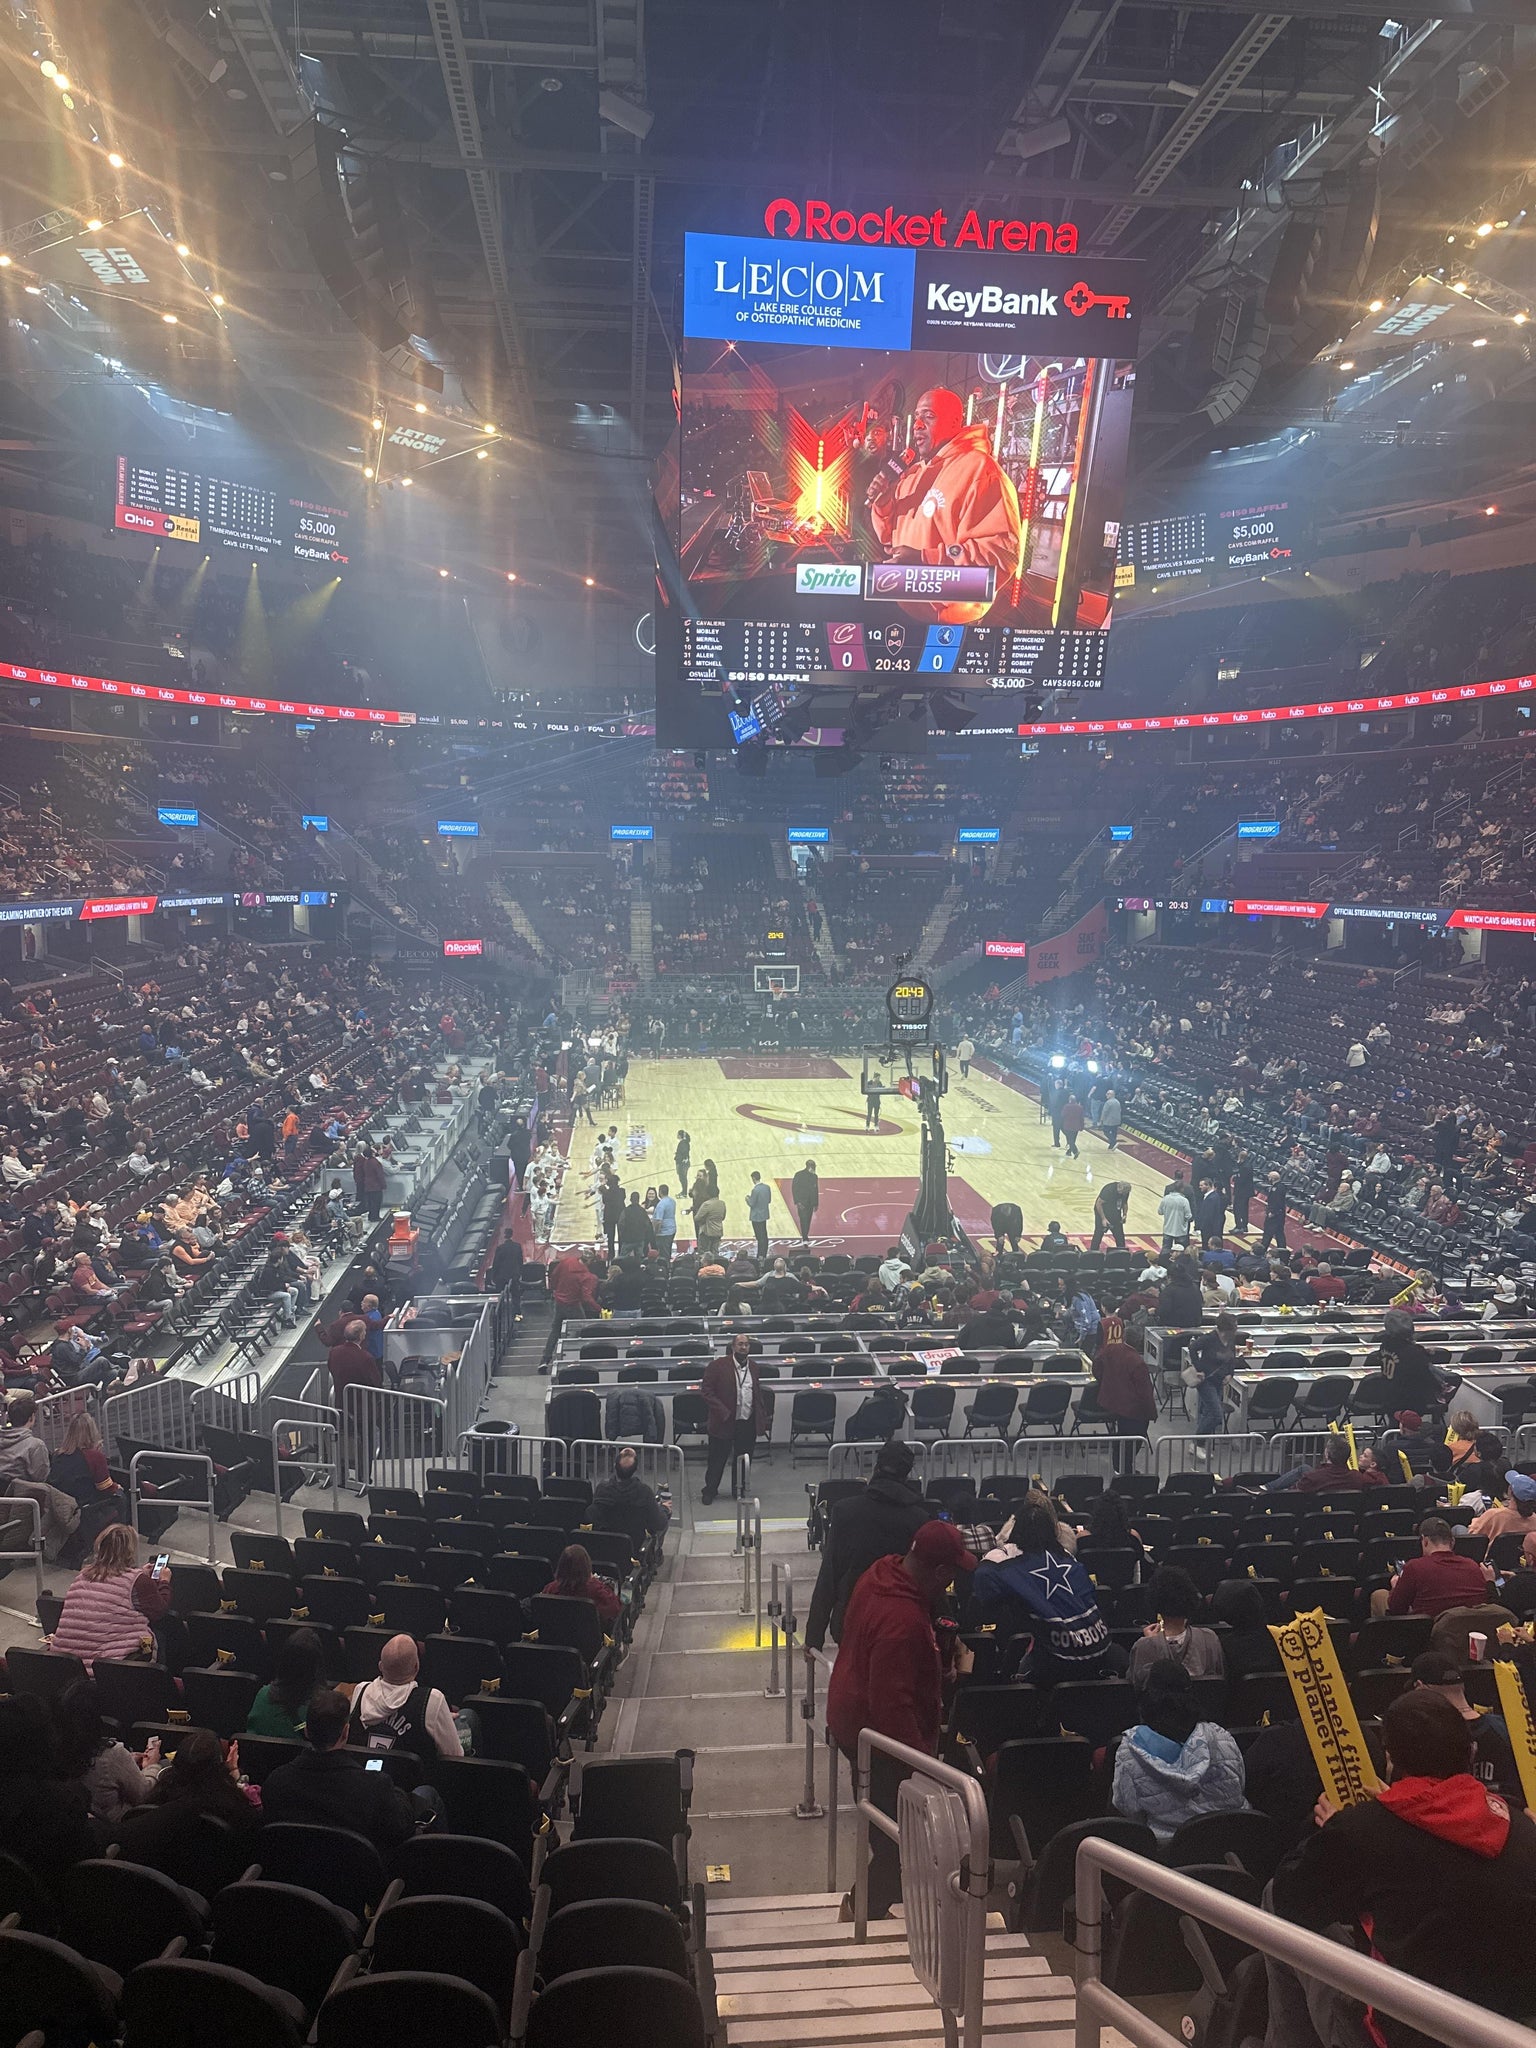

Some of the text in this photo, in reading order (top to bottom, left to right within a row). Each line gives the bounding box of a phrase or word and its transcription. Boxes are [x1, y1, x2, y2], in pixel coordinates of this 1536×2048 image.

[804, 199, 1078, 254] Rocket Arena
[105, 247, 150, 284] LET EM
[927, 283, 1058, 318] KeyBank
[754, 302, 842, 317] LAKE ERIE COLLEGE
[736, 311, 861, 329] OF OSTEOPATHIC MEDICINE
[395, 426, 447, 446] LET EM
[388, 434, 441, 455] KNOW.
[124, 513, 154, 527] Ohio
[299, 518, 336, 536] $5,000
[1232, 522, 1274, 540] $5,000
[294, 545, 330, 561] KeyBank
[1228, 552, 1269, 566] KeyBank
[800, 567, 857, 590] Sprite
[905, 568, 961, 582] DJ STEPH
[904, 581, 942, 593] FLOSS
[868, 631, 882, 641] 1Q
[842, 652, 852, 667] 0
[875, 659, 911, 671] 20:43
[932, 655, 943, 670] 0
[12, 667, 26, 679] fubo
[40, 672, 57, 684] fubo
[689, 668, 716, 678] oswald
[768, 673, 810, 681] RAFFLE
[71, 676, 88, 689] fubo
[991, 678, 1025, 689] $5,000
[1042, 679, 1101, 688] CAVS5050.COM
[1490, 684, 1506, 693] fubo
[1518, 680, 1532, 689] fubo
[131, 685, 146, 697] fubo
[1460, 688, 1476, 697] fubo
[188, 692, 205, 704] fubo
[1405, 695, 1419, 704] fubo
[250, 699, 266, 710] fubo
[308, 705, 325, 715] fubo
[1347, 702, 1363, 711] fubo
[369, 711, 385, 721] fubo
[1233, 713, 1248, 721] fubo
[1289, 708, 1304, 716] fubo
[1117, 721, 1132, 729] fubo
[1174, 717, 1189, 726] fubo
[610, 725, 615, 733] 0
[1060, 724, 1075, 732] fubo
[439, 824, 476, 833] PROGRESSIVE
[613, 828, 650, 837] PROGRESSIVE
[790, 830, 827, 839] PROGRESSIVE
[1239, 825, 1277, 834] PROGRESSIVE
[960, 831, 997, 840] PROGRESSIVE
[255, 896, 260, 904] 0
[265, 895, 299, 903] TURNOVERS
[1143, 900, 1211, 910] 0 20:43 0
[24, 909, 44, 919] PARTNER
[60, 907, 73, 916] CAVS
[1334, 907, 1438, 921] OFFICIAL STREAMING PARTNER OF THE CAVS
[1463, 915, 1536, 927] WATCH CAVS GAMES LIVE
[398, 950, 439, 958] LECOM
[995, 944, 1024, 955] Rocket
[1039, 952, 1059, 961] SEAT
[1037, 961, 1060, 969] GEEK
[895, 986, 924, 998] 20:43
[719, 1238, 845, 1251] Michlob
[1107, 1325, 1122, 1340] 10
[924, 1350, 953, 1360] drug
[1381, 1357, 1395, 1380] 10
[1050, 1618, 1108, 1648] COWBOYS
[1302, 1625, 1316, 1642] pf
[1285, 1635, 1303, 1653] pf
[1310, 1657, 1369, 1802] planet fitne
[1292, 1669, 1354, 1806] planet fitn
[1472, 1761, 1494, 1781] EID
